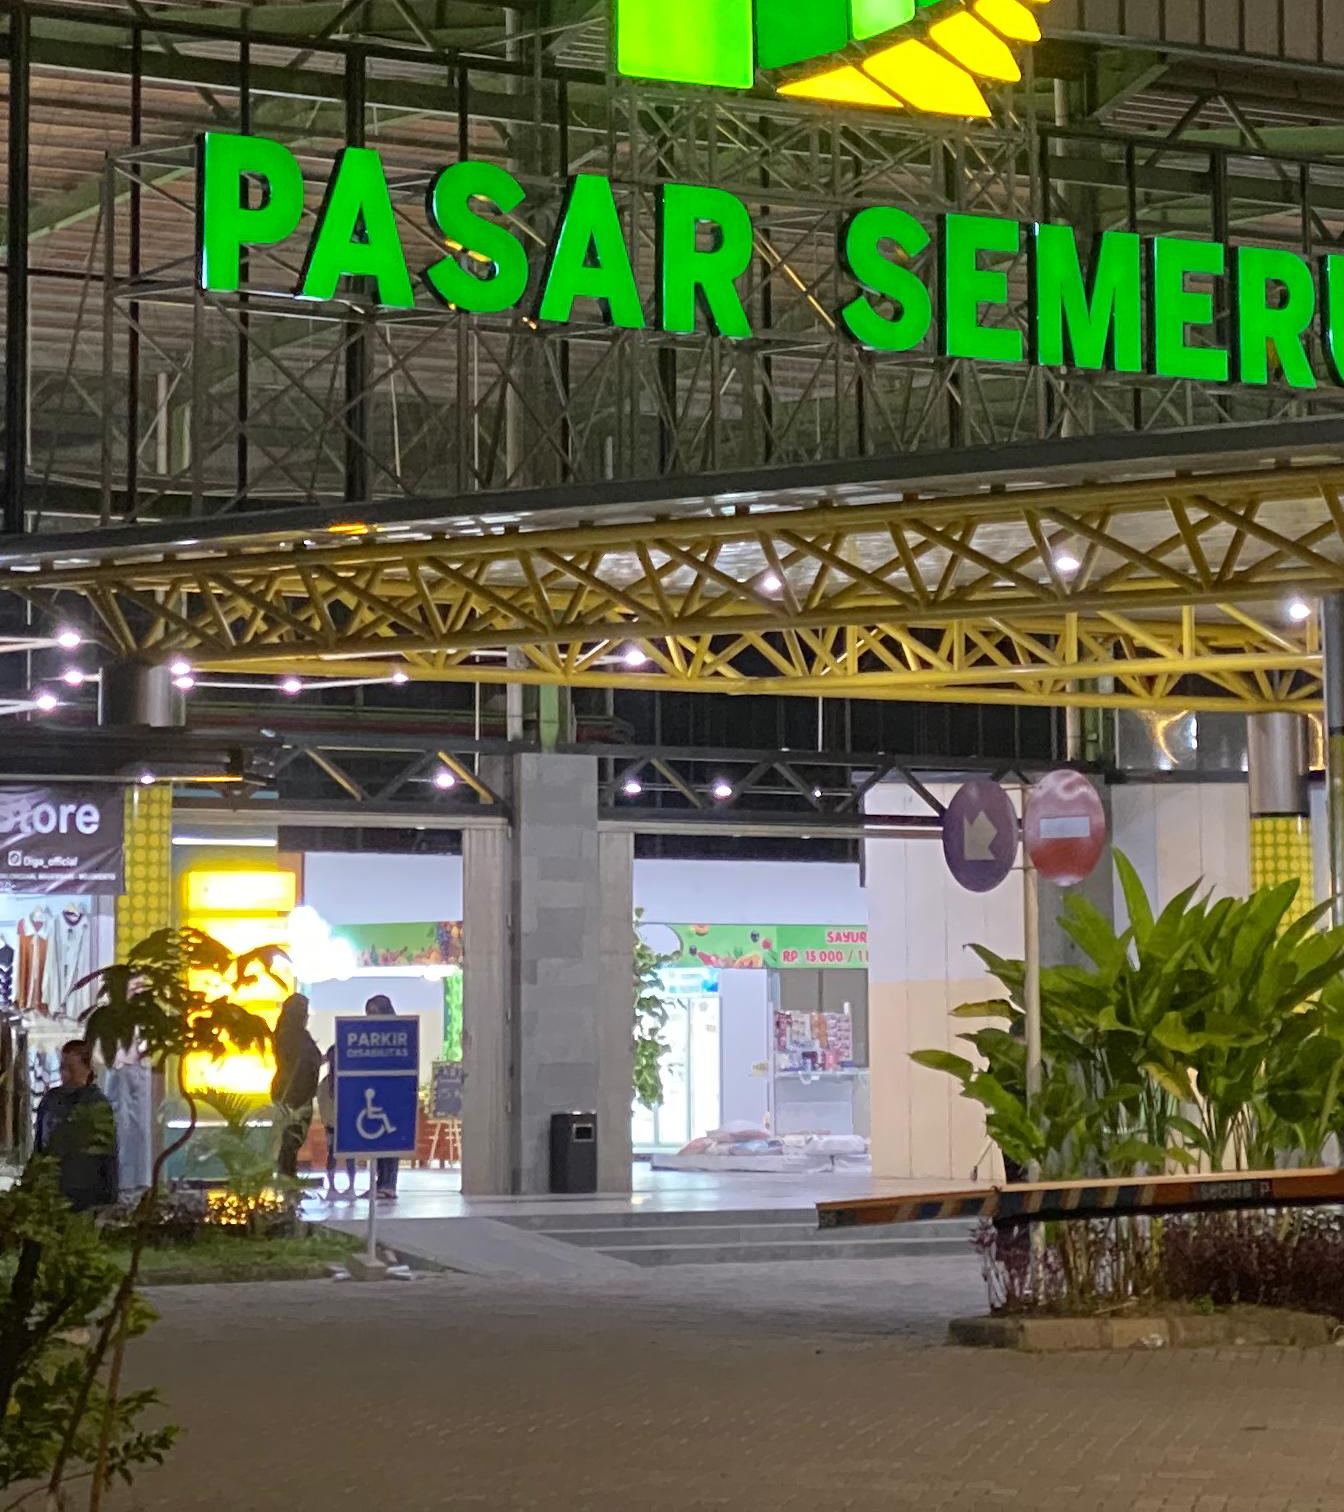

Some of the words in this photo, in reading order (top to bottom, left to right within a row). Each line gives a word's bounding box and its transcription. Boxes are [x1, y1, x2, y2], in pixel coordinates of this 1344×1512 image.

[200, 131, 753, 340] PASAR
[782, 950, 799, 962] RP
[347, 1032, 408, 1046] PARKIR
[346, 1048, 408, 1058] DISABILITAS
